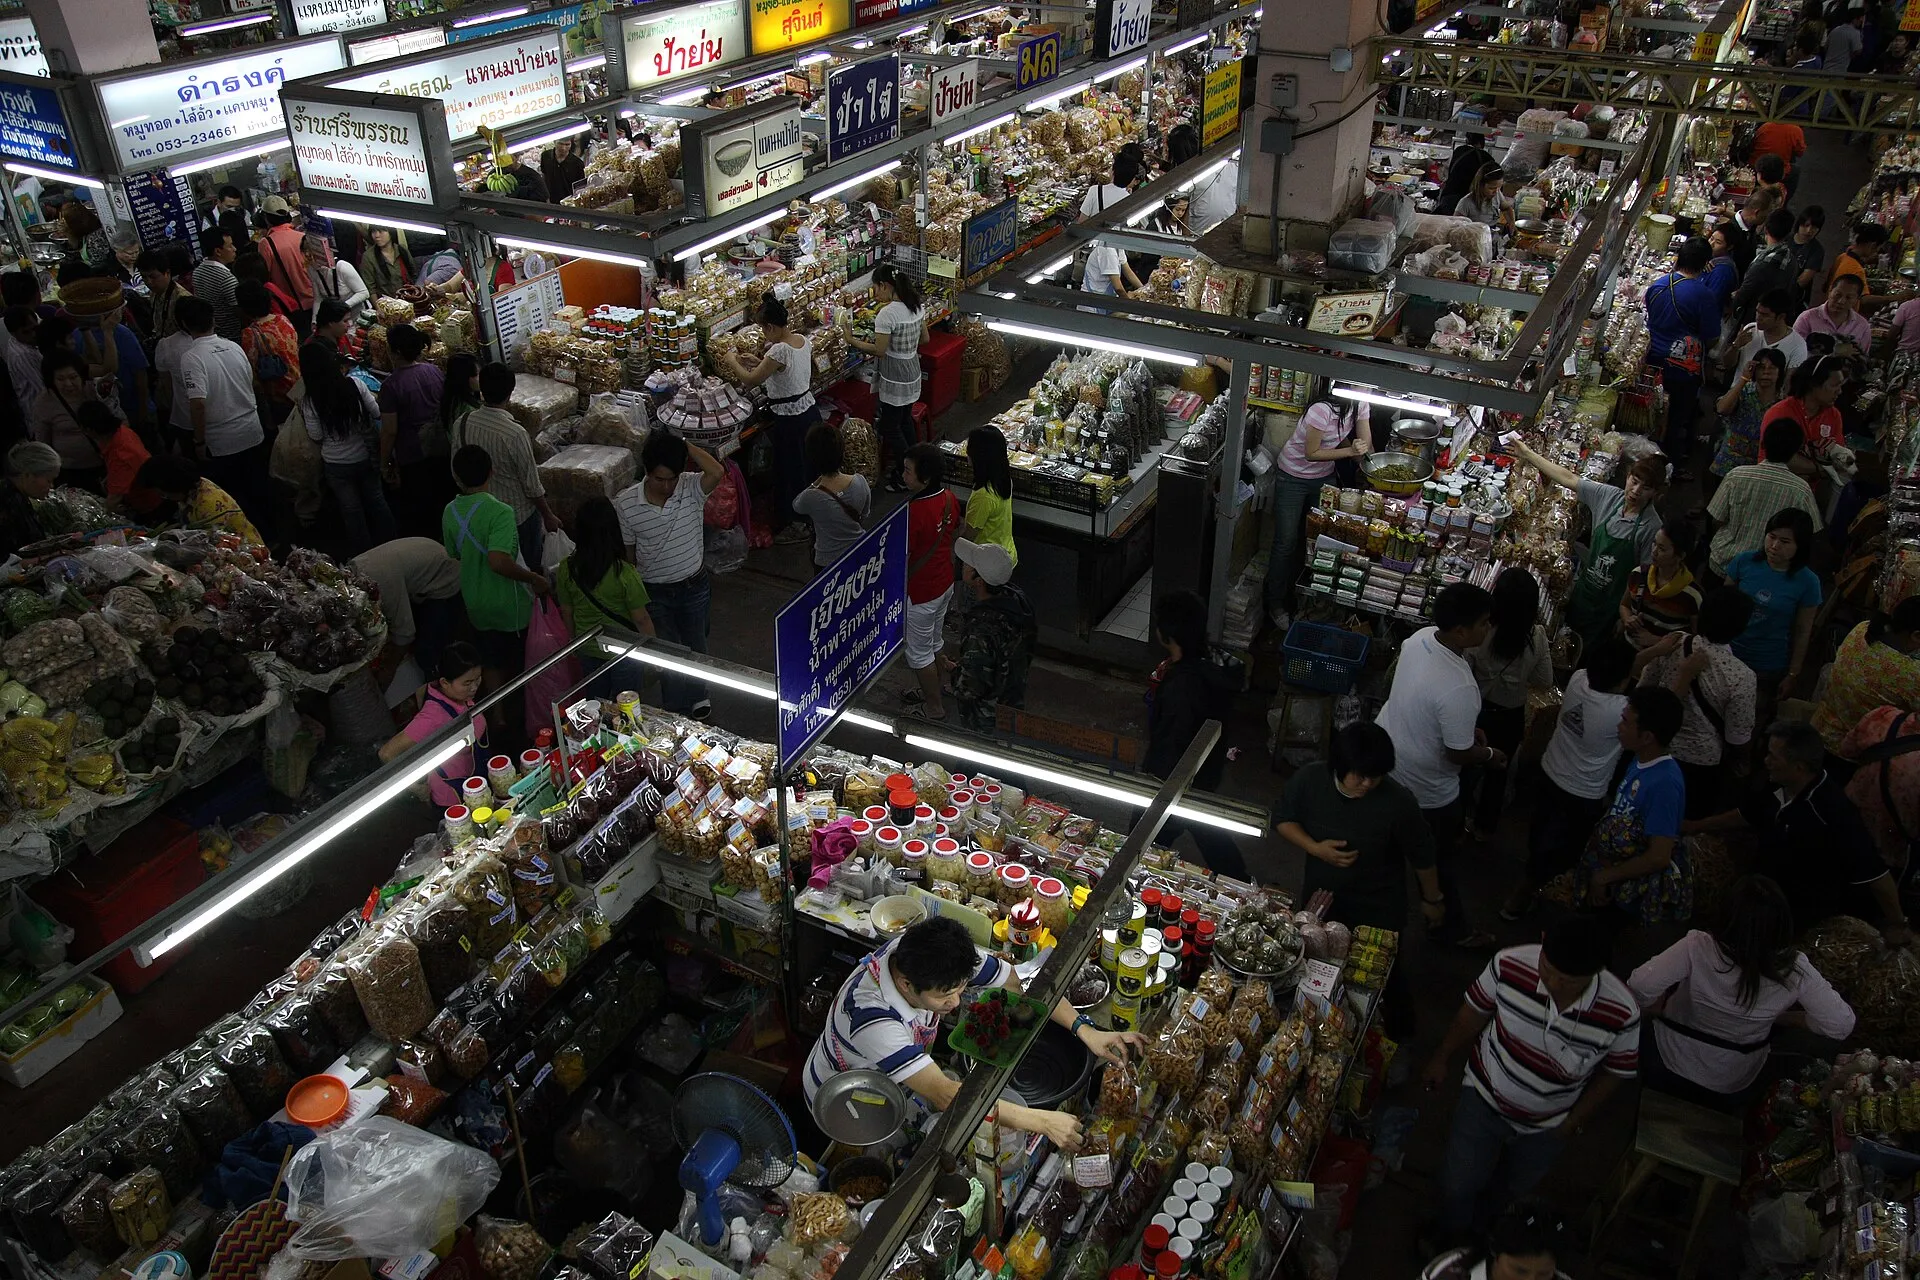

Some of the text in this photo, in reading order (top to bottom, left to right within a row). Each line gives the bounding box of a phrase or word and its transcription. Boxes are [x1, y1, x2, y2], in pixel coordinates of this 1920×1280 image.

[782, 3, 824, 41] สุจินต์
[1111, 1, 1149, 50] ป้าย่น
[465, 45, 558, 85] แหนมป้าย่น
[654, 29, 722, 76] ป้าย่น
[177, 57, 286, 103] ดำรงค์
[935, 72, 974, 118] ป้าย่น
[123, 95, 268, 141] หมูทอด ไส้อั่ว แคบหมู
[292, 105, 409, 146] ร้านศรีพรรณ
[480, 93, 562, 123] 053-422550
[156, 125, 238, 153] 053-234661
[295, 141, 426, 177] หมูทอด ไส้อั่ว น้ำพริกหนุ่ม
[758, 119, 800, 156] แหนมป้าใส
[308, 173, 359, 192] แหนมหม้อ
[808, 588, 886, 673] น้ำพริกหนุ่ม
[824, 623, 881, 688] หมูยอเห็ดหอม
[829, 676, 852, 712] (053)
[856, 638, 888, 681] 251737
